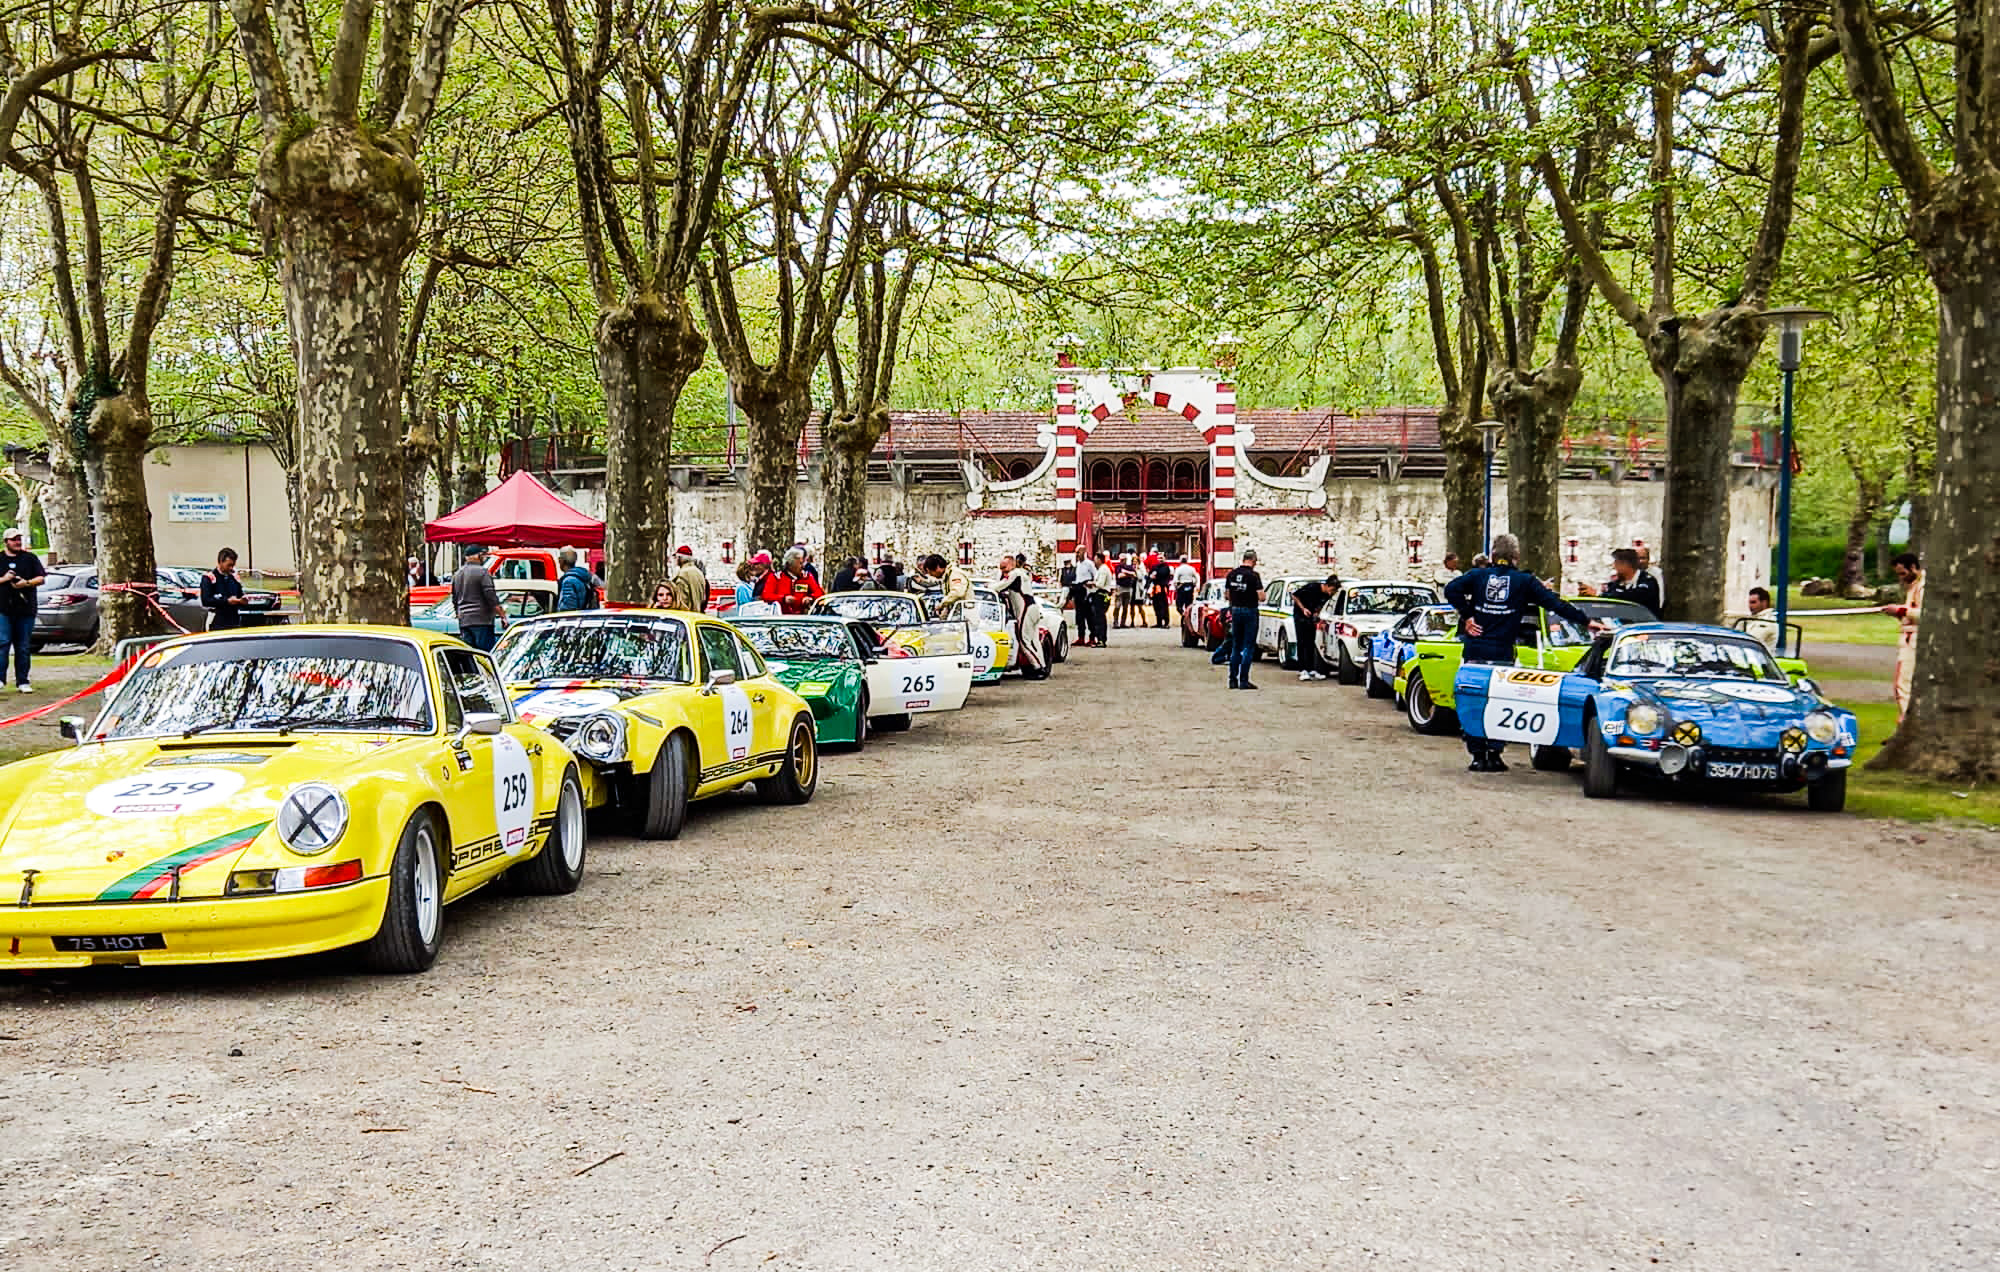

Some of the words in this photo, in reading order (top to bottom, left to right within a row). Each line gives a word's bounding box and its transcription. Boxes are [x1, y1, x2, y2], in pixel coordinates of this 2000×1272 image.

[1375, 587, 1410, 595] FORD
[902, 675, 936, 693] 265
[1511, 671, 1559, 684] BIC
[730, 709, 748, 735] 264
[1497, 707, 1546, 733] 260
[1603, 720, 1625, 735] elf
[1709, 762, 1743, 777] 3947
[114, 782, 215, 797] 259
[503, 772, 527, 812] 259
[68, 938, 97, 950] 75
[102, 935, 145, 949] HOT
